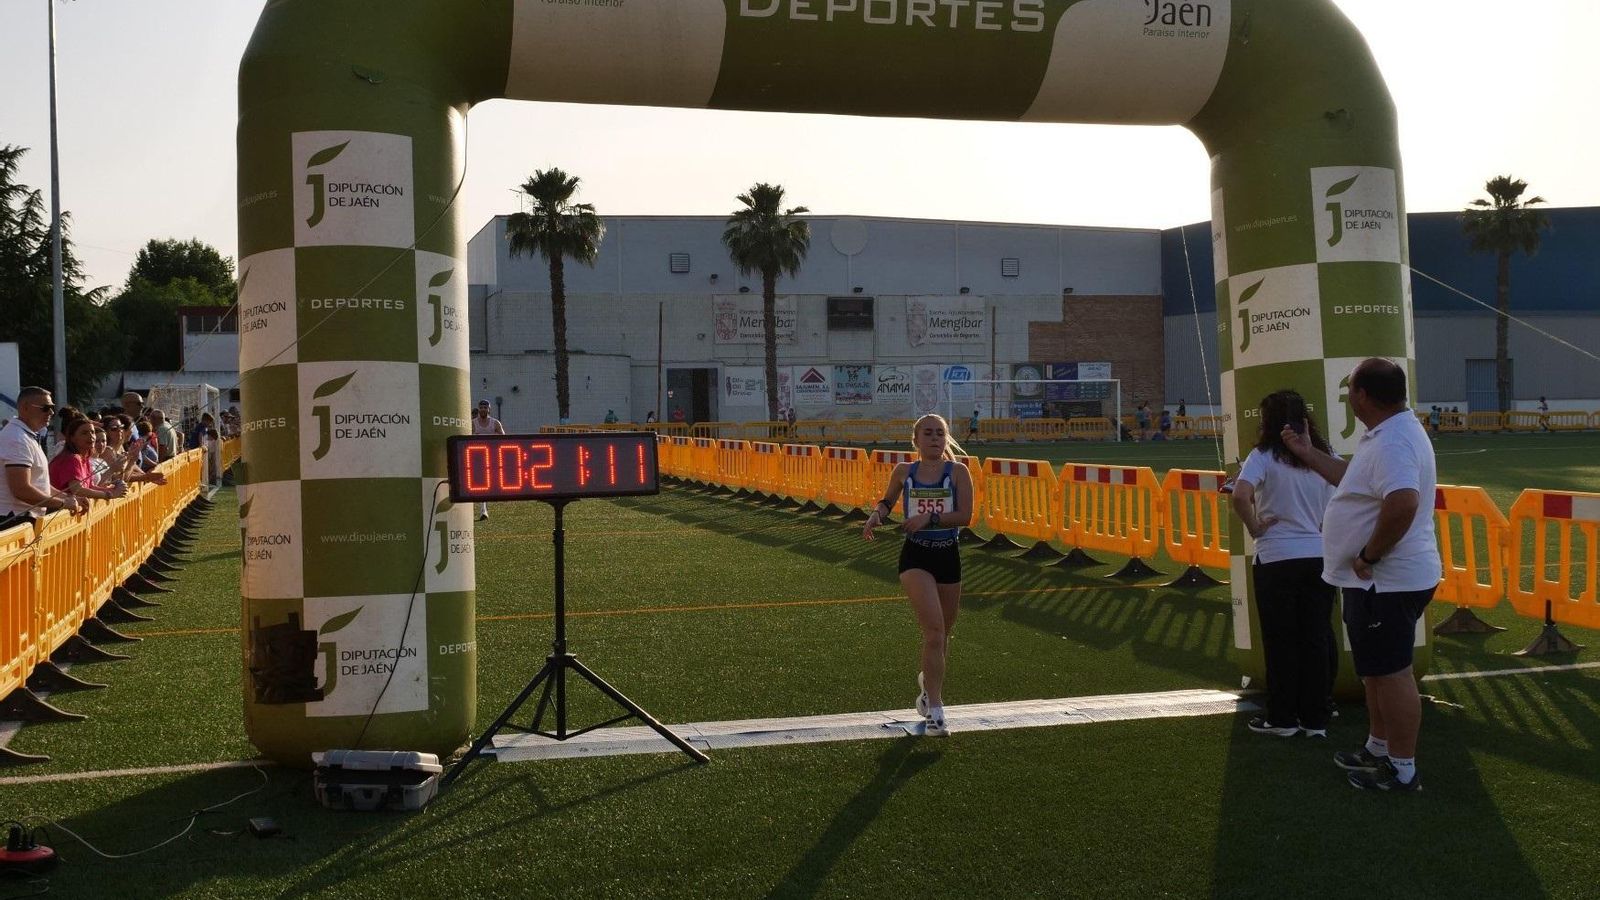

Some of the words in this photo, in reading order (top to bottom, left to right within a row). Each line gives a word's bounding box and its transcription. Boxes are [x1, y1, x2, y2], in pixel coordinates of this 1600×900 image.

[739, 0, 1045, 32] DEPORTES
[328, 183, 403, 197] DIPUTACIÓN
[329, 197, 346, 207] DE
[349, 196, 380, 208] JAÉN
[1345, 221, 1359, 230] DE
[311, 298, 405, 310] DEPORTES
[1333, 304, 1399, 314] DEPORTES
[1251, 307, 1311, 323] DIPUTACIÓN
[930, 317, 983, 331] Mengíbar
[1252, 325, 1264, 334] DE
[1265, 322, 1290, 333] JAÉN
[877, 383, 910, 393] ANAMA
[335, 412, 410, 425] DIPUTACIÓN
[335, 429, 352, 439] DE
[354, 426, 386, 439] JAÉN
[466, 444, 645, 491] 00:21:11
[917, 499, 945, 514] 555
[320, 532, 407, 544] www.dipujaen.es
[341, 646, 417, 662] DIPUTACIÓN
[341, 665, 358, 676] DE
[361, 662, 393, 676] JAÉN
